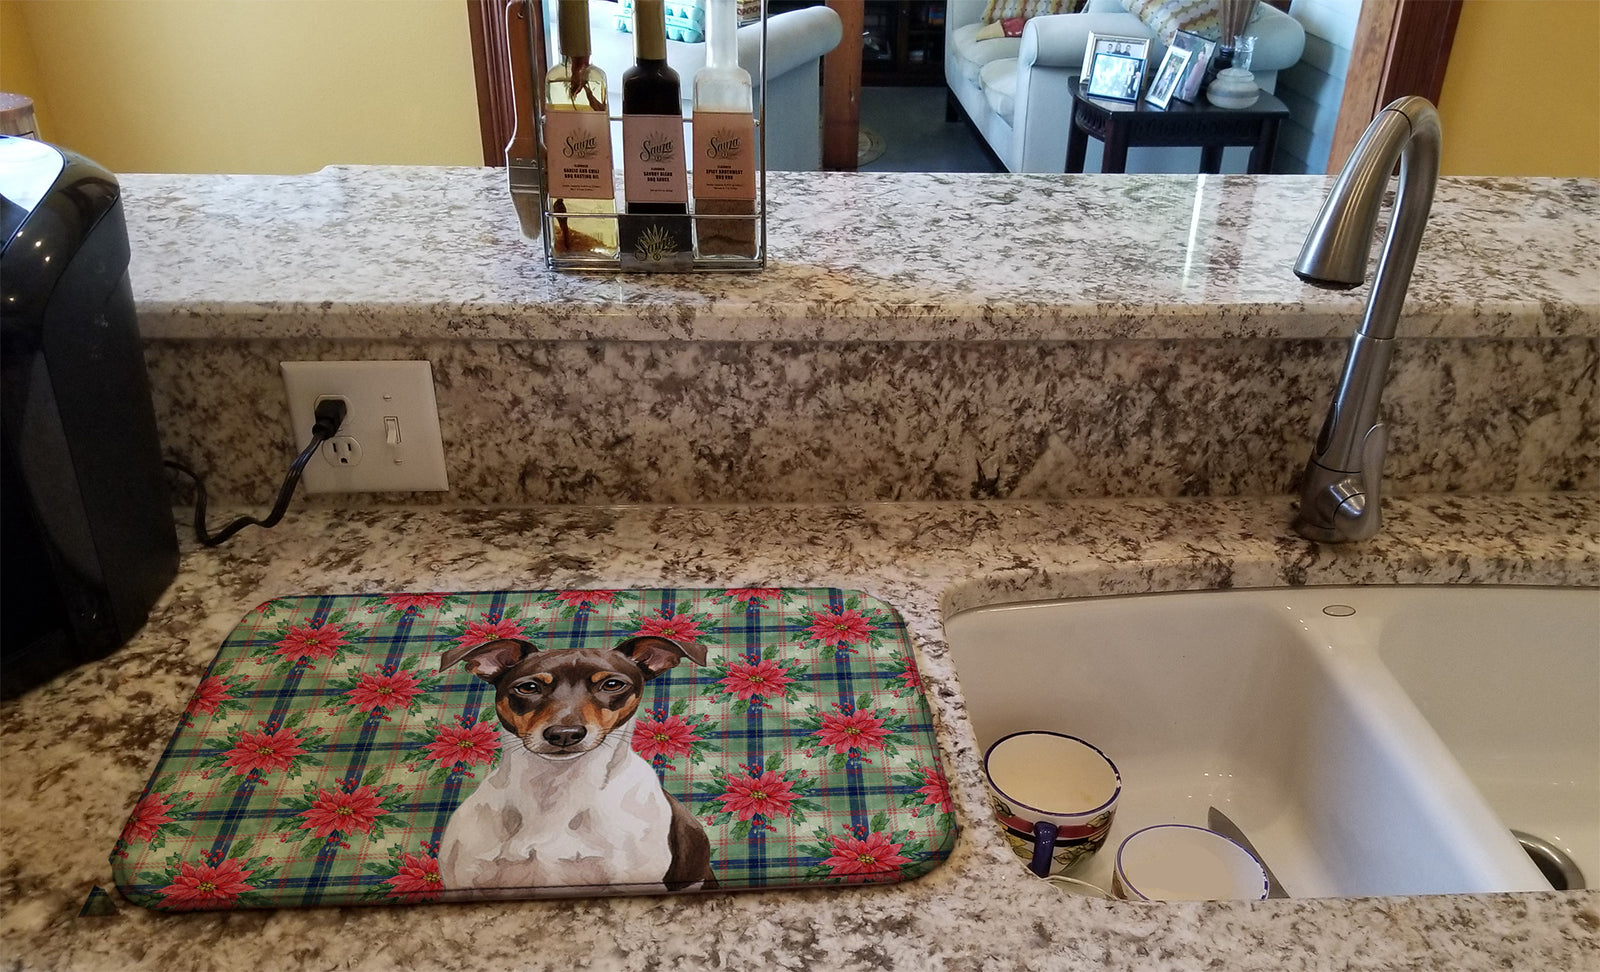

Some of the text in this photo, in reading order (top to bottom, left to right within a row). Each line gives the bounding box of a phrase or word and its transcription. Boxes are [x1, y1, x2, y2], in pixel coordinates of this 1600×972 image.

[563, 136, 597, 158] Sauza
[640, 140, 673, 162] Sauza
[706, 136, 739, 159] Sauza
